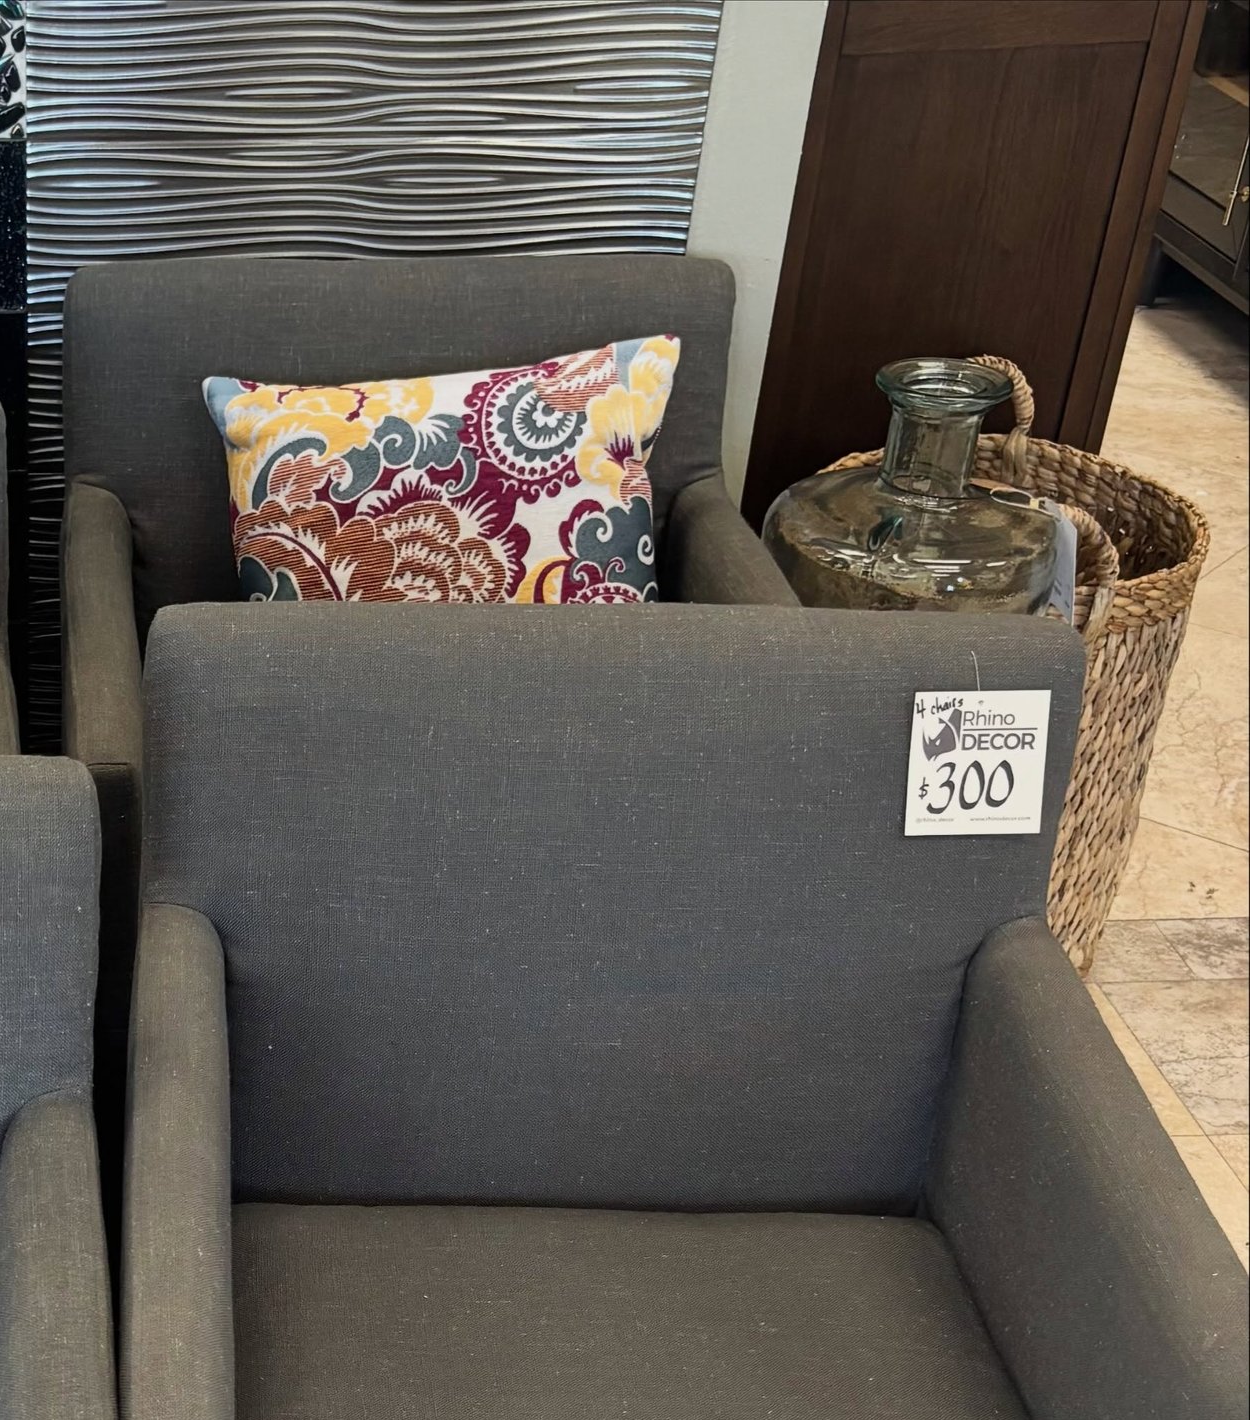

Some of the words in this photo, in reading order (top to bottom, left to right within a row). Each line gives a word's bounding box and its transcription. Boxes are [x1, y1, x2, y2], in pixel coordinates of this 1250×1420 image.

[915, 698, 926, 719] 4
[930, 696, 963, 714] chairs
[962, 709, 1016, 726] Rhino
[961, 733, 1036, 751] DECOR
[918, 760, 1015, 815] $300
